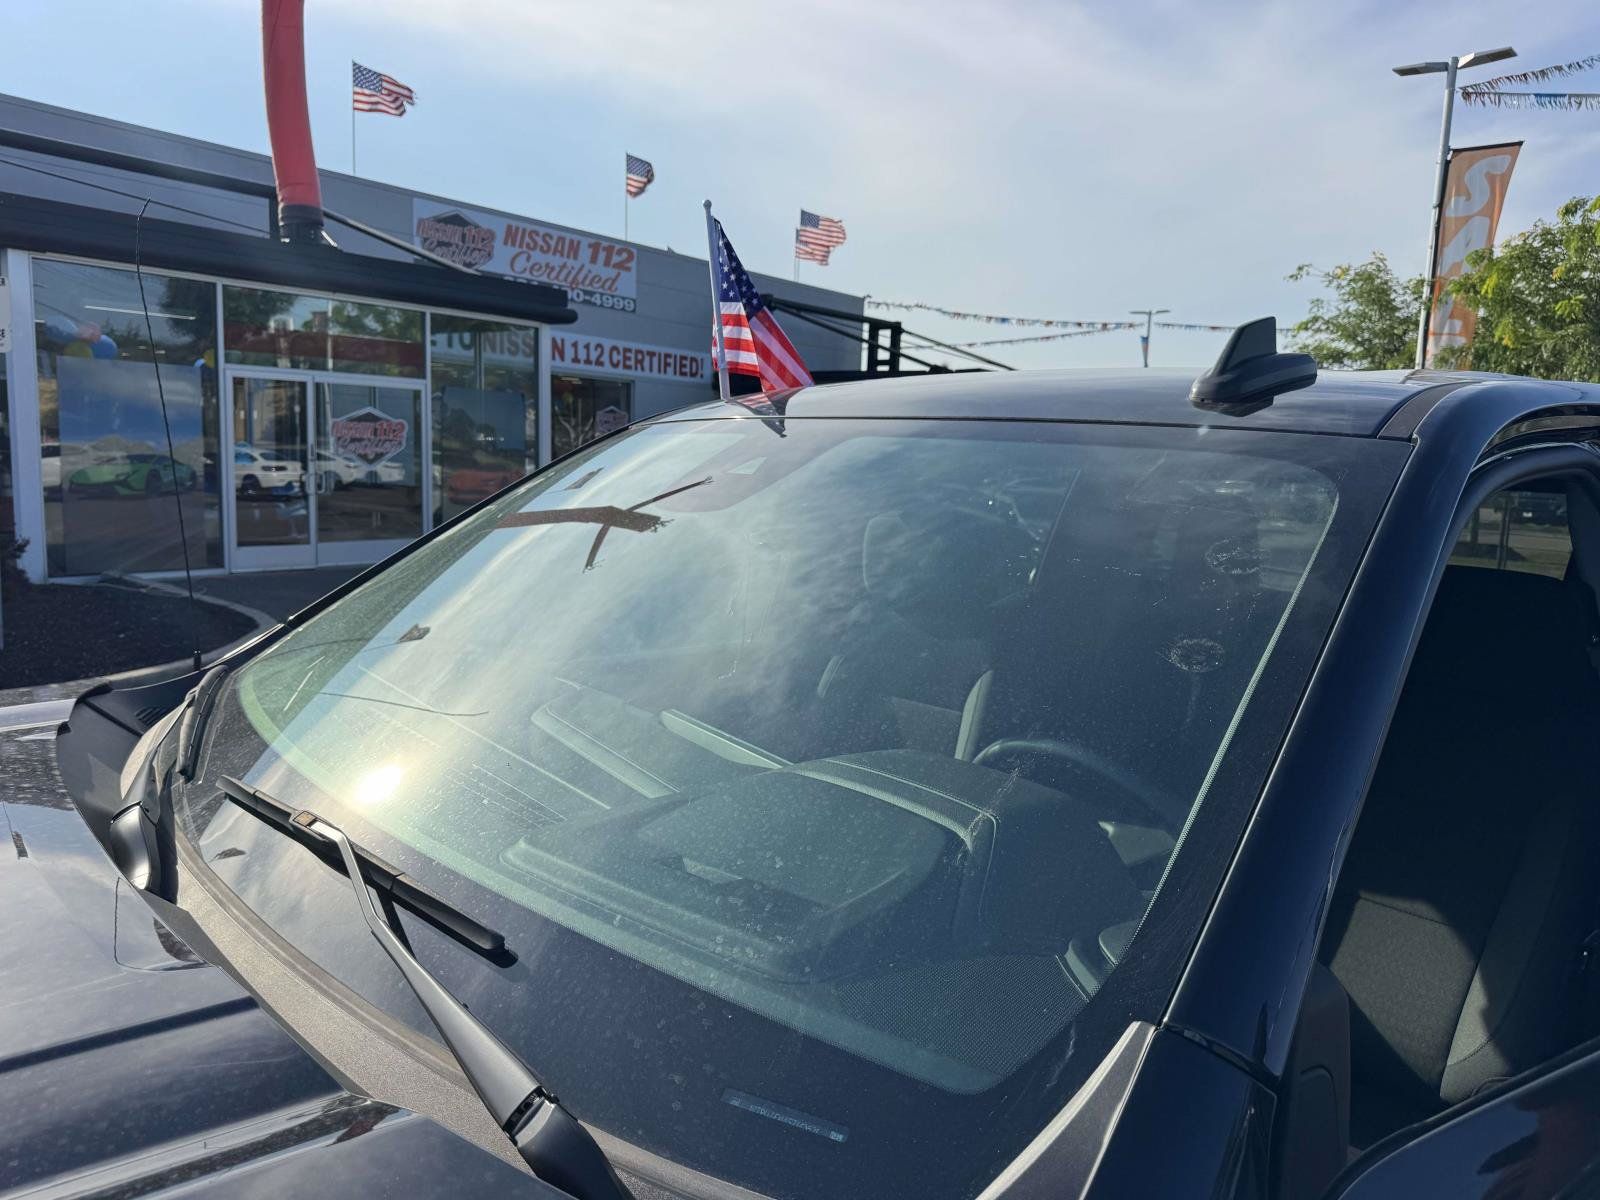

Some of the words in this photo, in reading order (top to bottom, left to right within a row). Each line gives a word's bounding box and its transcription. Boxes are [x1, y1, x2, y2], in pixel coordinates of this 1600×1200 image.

[503, 223, 582, 261] NISSAN
[587, 240, 636, 273] 112
[510, 250, 622, 293] Certified
[482, 329, 566, 362] NISSN
[571, 340, 605, 367] 112
[609, 345, 704, 379] CERTIFIED!
